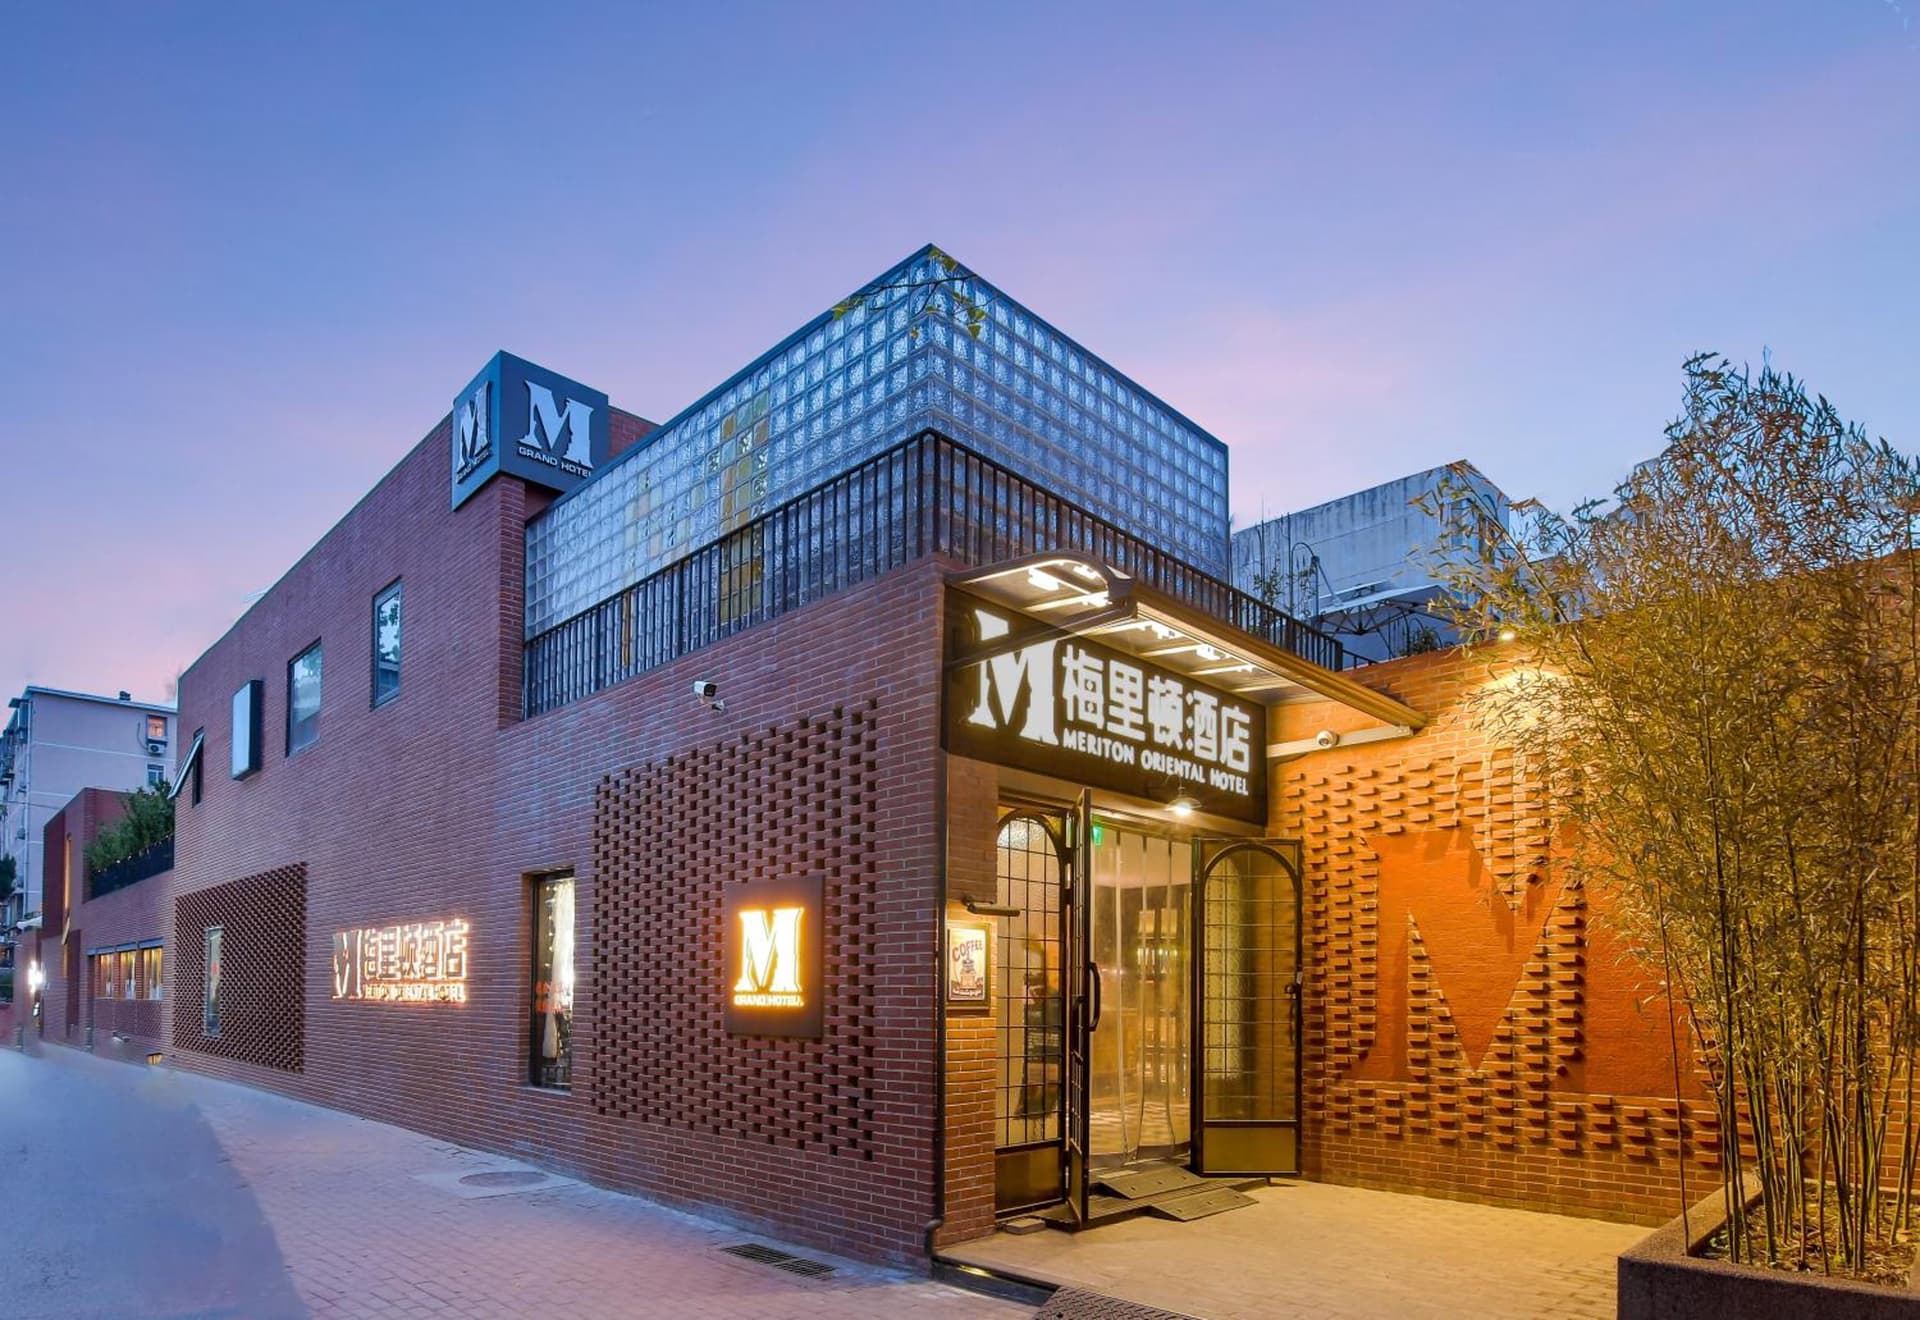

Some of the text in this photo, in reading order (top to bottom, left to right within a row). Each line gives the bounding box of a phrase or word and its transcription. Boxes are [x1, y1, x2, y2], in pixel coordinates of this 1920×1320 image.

[517, 380, 594, 468] M
[519, 446, 558, 466] GRAND
[968, 609, 1058, 745] M
[1062, 644, 1250, 772] 梅里顿酒店
[1063, 728, 1249, 795] MERITON ORIENTAL HOTEL
[734, 907, 805, 992] M
[952, 939, 983, 962] COFFEE
